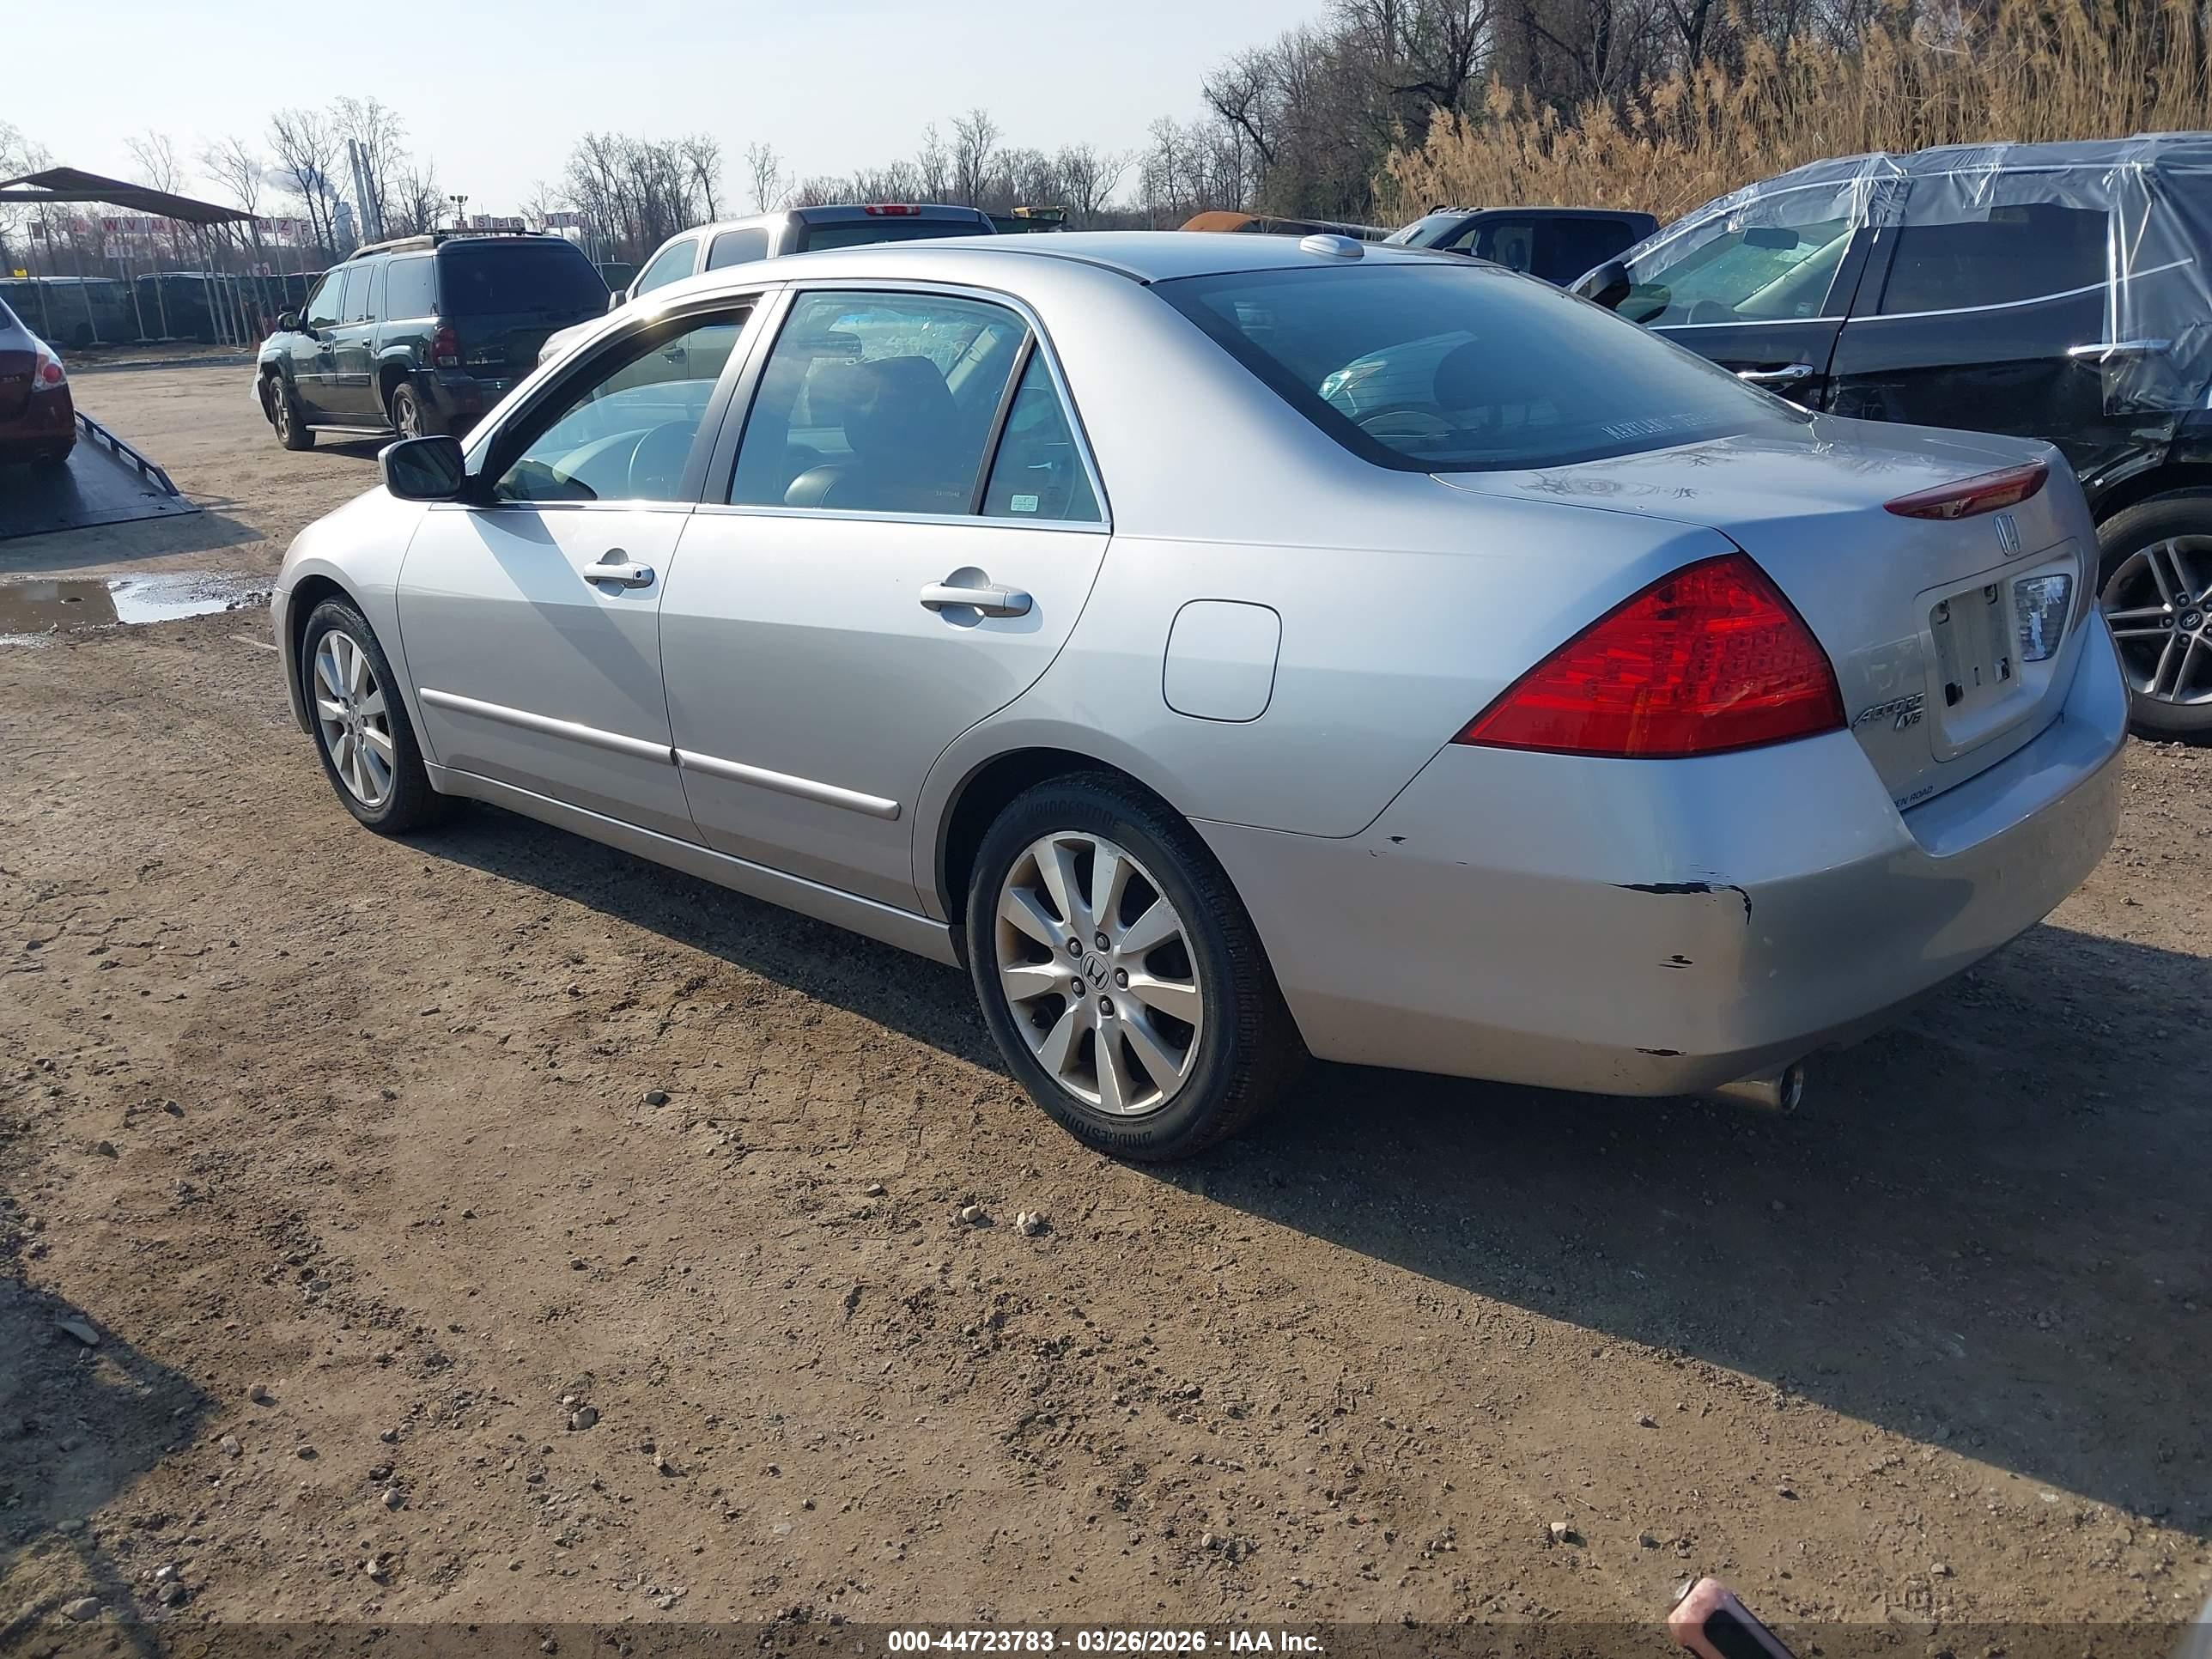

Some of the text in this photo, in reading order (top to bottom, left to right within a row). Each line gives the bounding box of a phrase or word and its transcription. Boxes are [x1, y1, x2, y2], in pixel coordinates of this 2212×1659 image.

[104, 220, 118, 232] W
[126, 220, 136, 231] V
[281, 220, 289, 231] Z
[477, 217, 485, 227] S
[1909, 785, 1933, 803] ROAD
